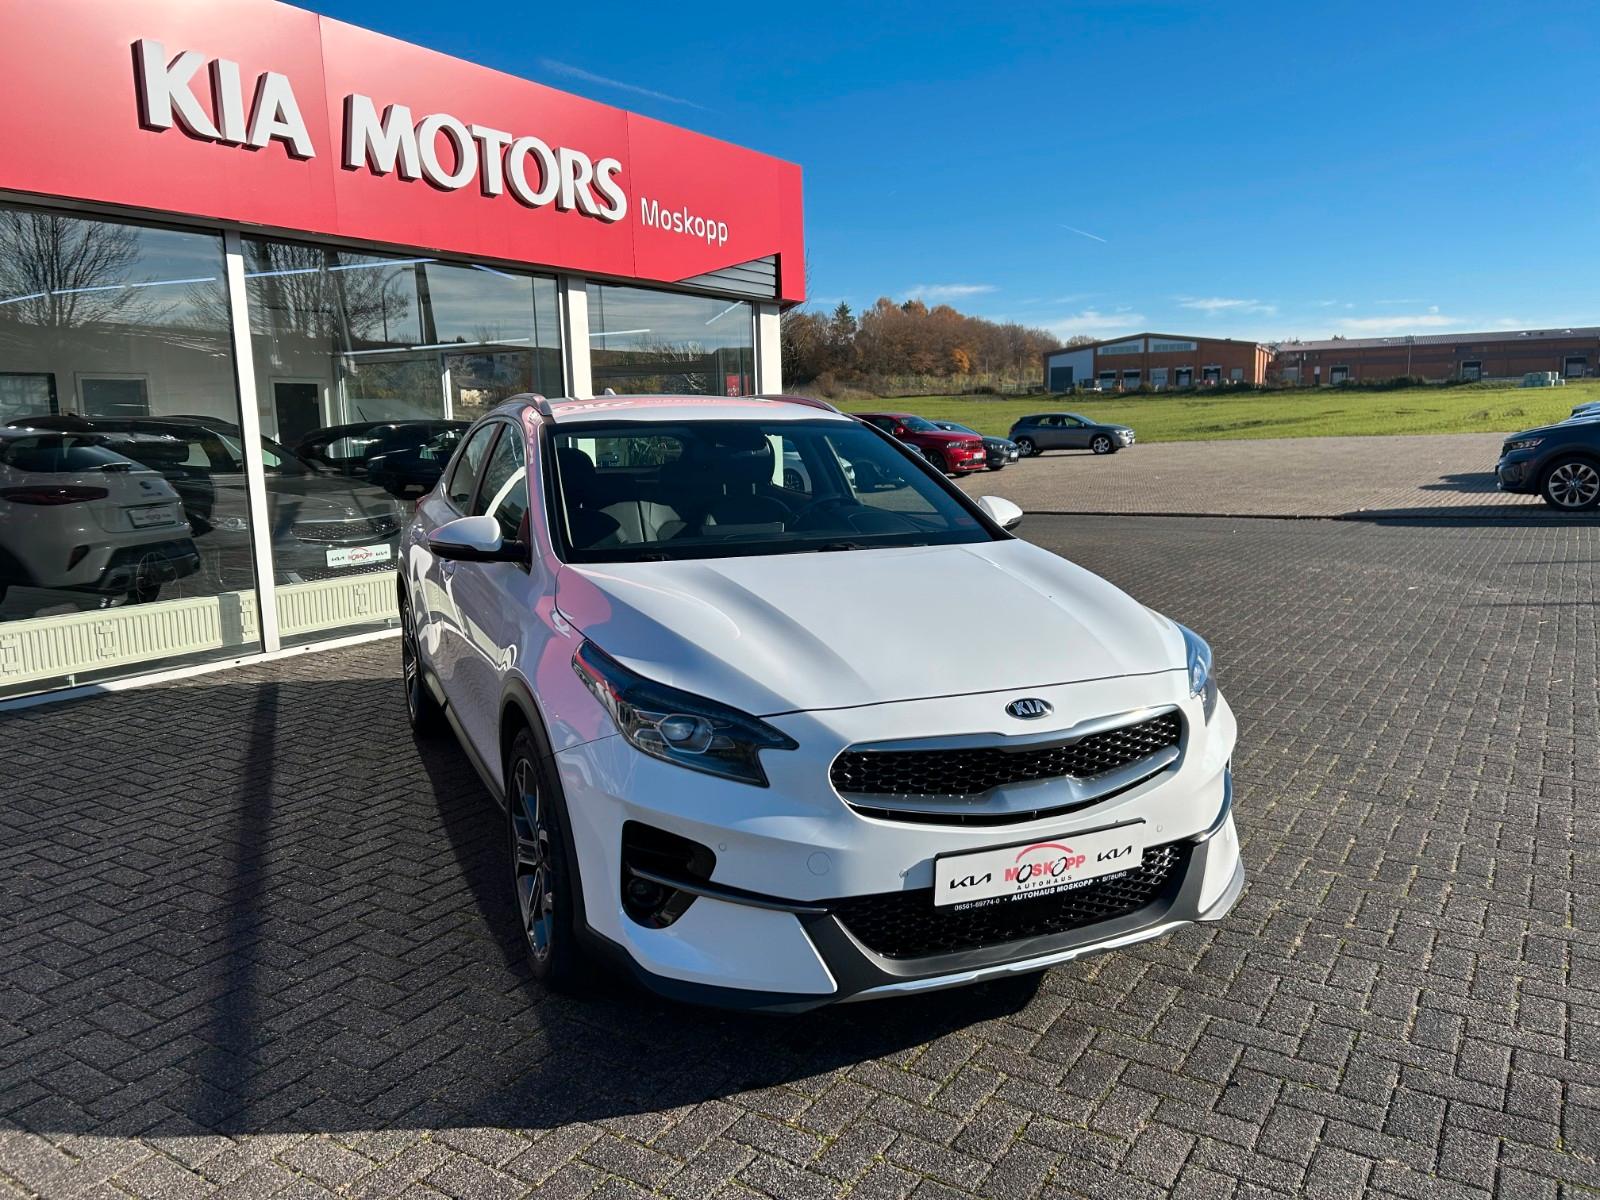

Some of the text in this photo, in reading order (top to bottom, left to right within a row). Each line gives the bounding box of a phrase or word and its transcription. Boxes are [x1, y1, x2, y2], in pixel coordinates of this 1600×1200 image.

[131, 38, 628, 224] KIA MOTORS
[641, 196, 729, 248] Moskopp
[1011, 700, 1052, 716] KIA
[1004, 854, 1086, 884] MOSKOPP
[1011, 887, 1056, 902] AUTOHAUS
[1056, 878, 1094, 893] MOSKOPP
[1017, 875, 1073, 891] AUTOHAUS
